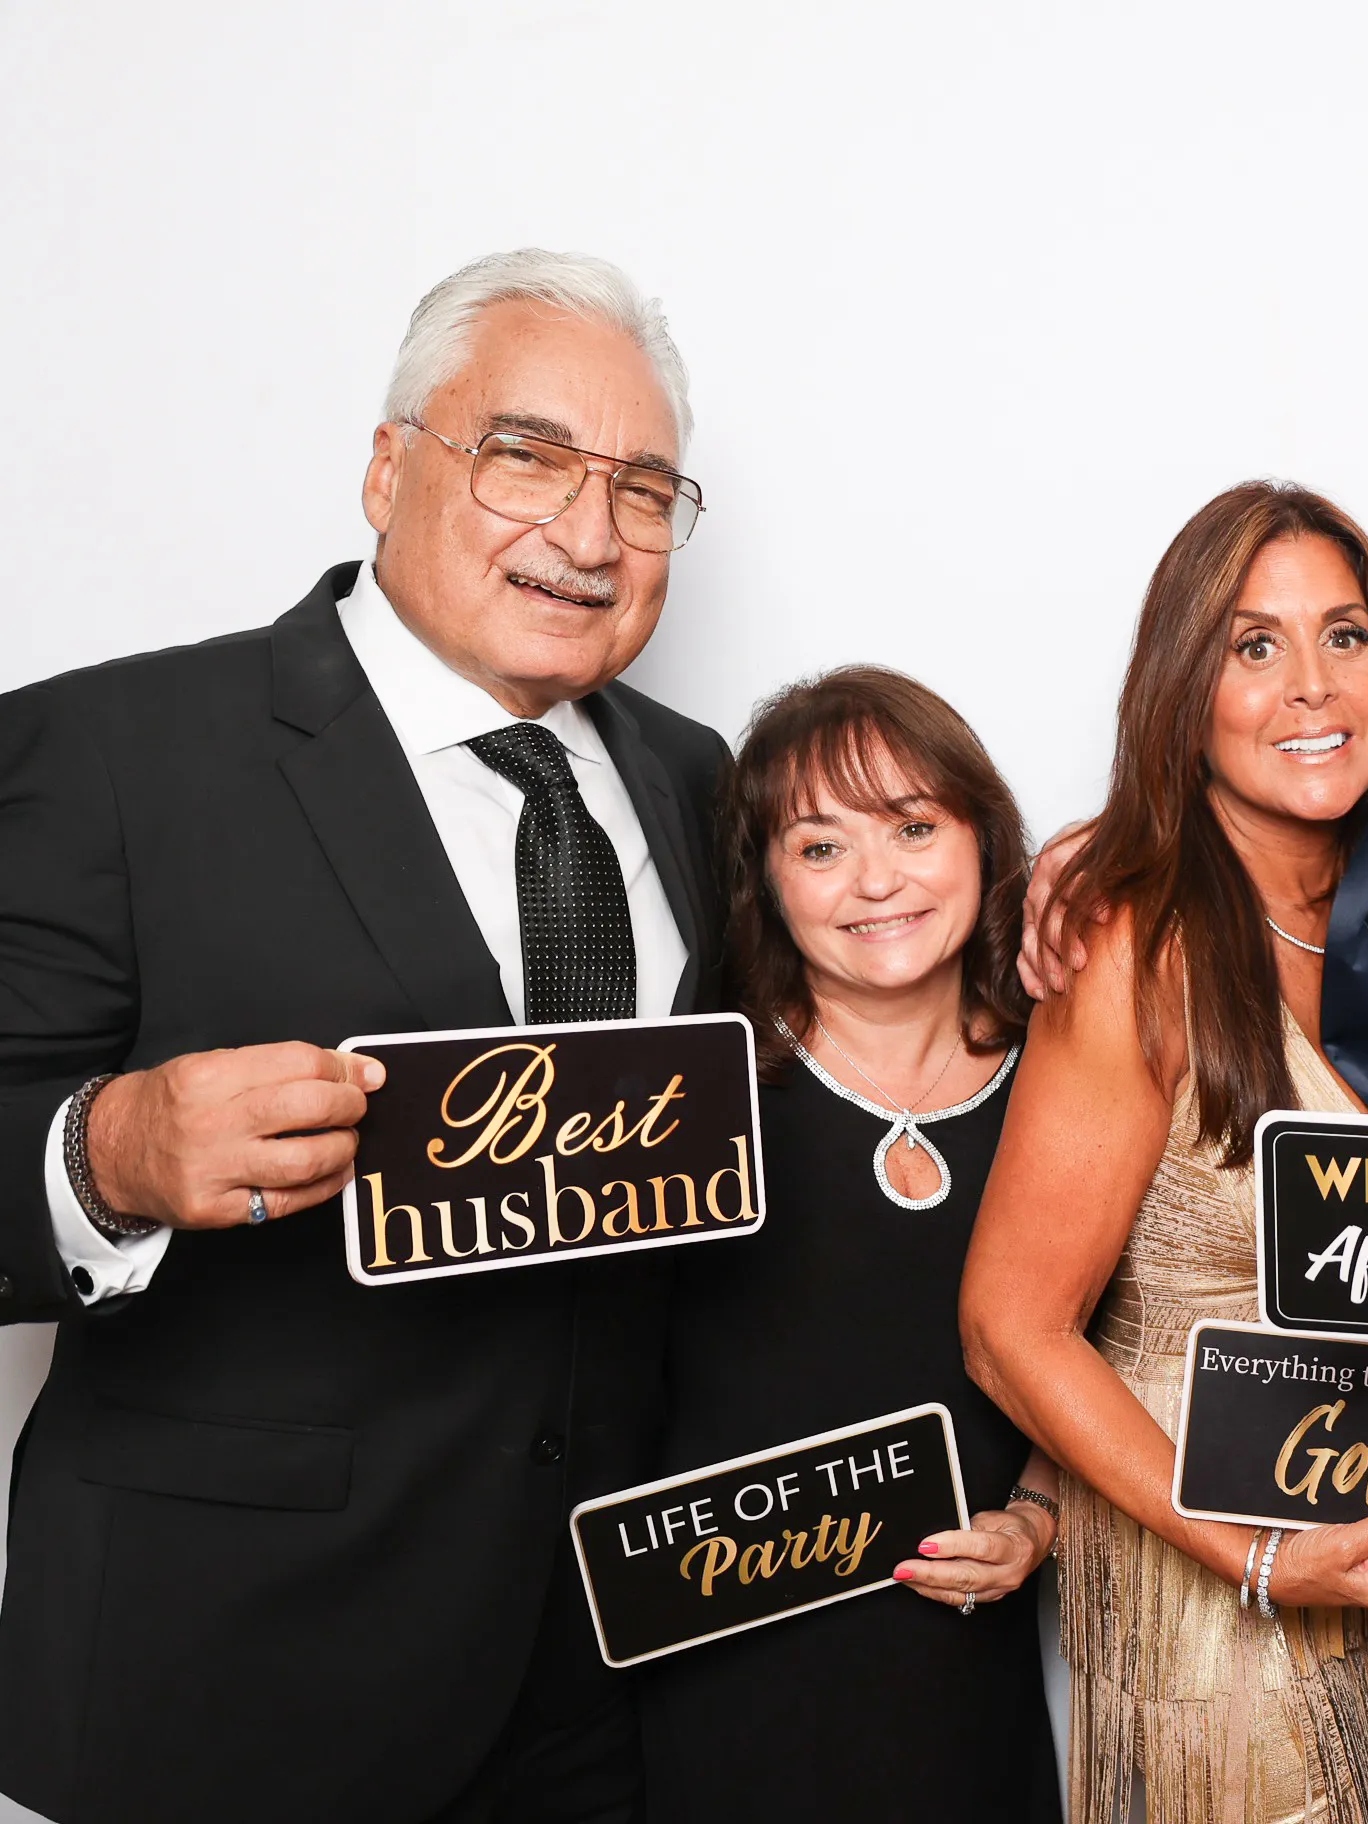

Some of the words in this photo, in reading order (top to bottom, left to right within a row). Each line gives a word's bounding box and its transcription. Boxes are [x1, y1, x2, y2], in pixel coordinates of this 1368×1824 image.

[427, 1043, 686, 1168] Best
[362, 1135, 759, 1268] husband
[1200, 1347, 1355, 1392] Everything
[618, 1498, 719, 1558] LIFE
[734, 1472, 800, 1521] OF
[815, 1440, 914, 1497] THE
[680, 1512, 883, 1596] Party
